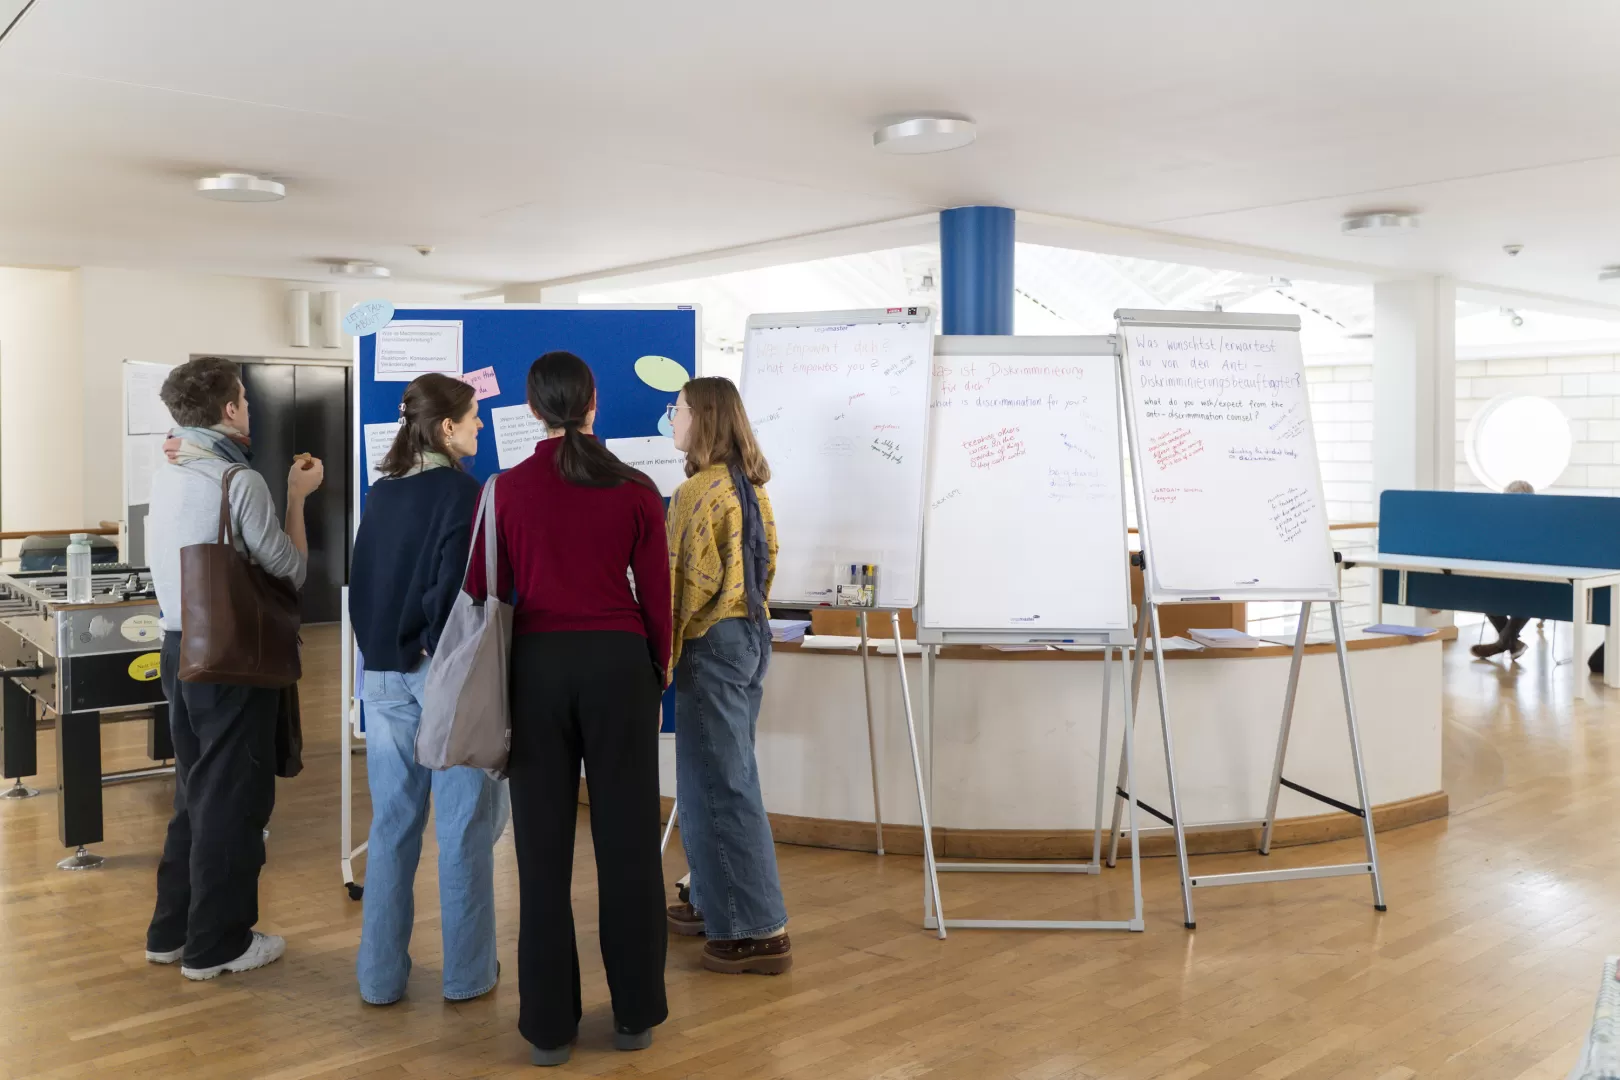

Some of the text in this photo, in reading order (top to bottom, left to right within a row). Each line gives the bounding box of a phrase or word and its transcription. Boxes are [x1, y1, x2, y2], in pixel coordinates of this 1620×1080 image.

[366, 303, 384, 313] TALK
[355, 313, 380, 330] ABOUT
[1136, 334, 1159, 348] Was
[960, 363, 976, 377] ist
[1162, 359, 1179, 368] von
[1047, 394, 1059, 410] for
[1143, 397, 1162, 406] what
[1169, 398, 1178, 406] do
[1183, 400, 1194, 408] you
[1249, 399, 1267, 409] from
[1271, 400, 1284, 408] the
